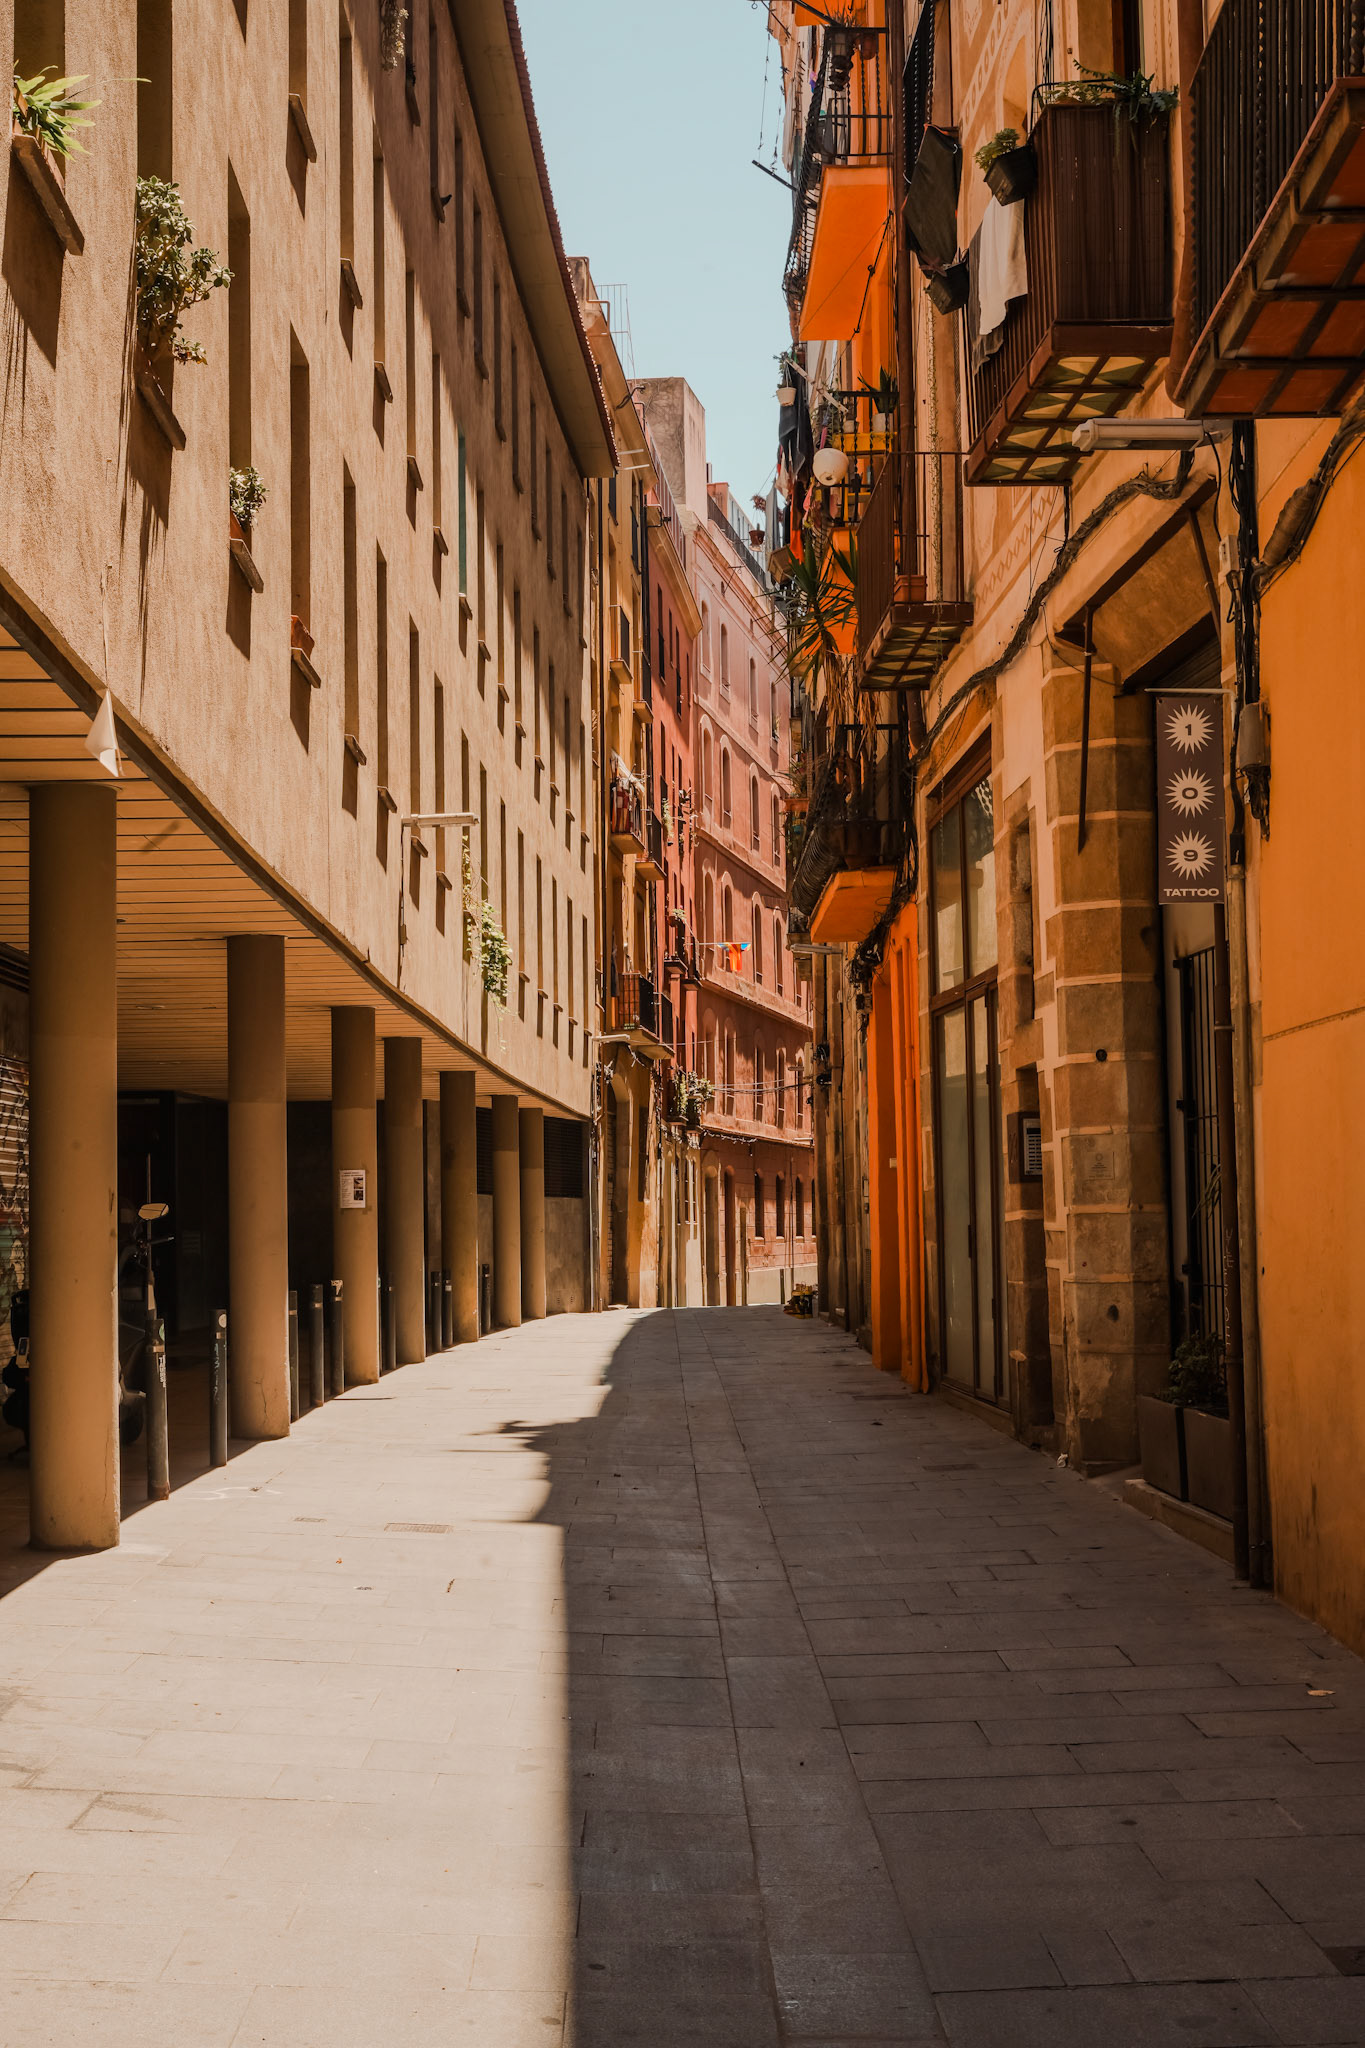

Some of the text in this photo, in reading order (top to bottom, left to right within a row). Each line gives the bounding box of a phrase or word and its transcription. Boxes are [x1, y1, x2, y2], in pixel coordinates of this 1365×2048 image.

[1185, 724, 1192, 736] 1
[1183, 850, 1199, 862] 9
[1163, 888, 1220, 897] TATTOO
